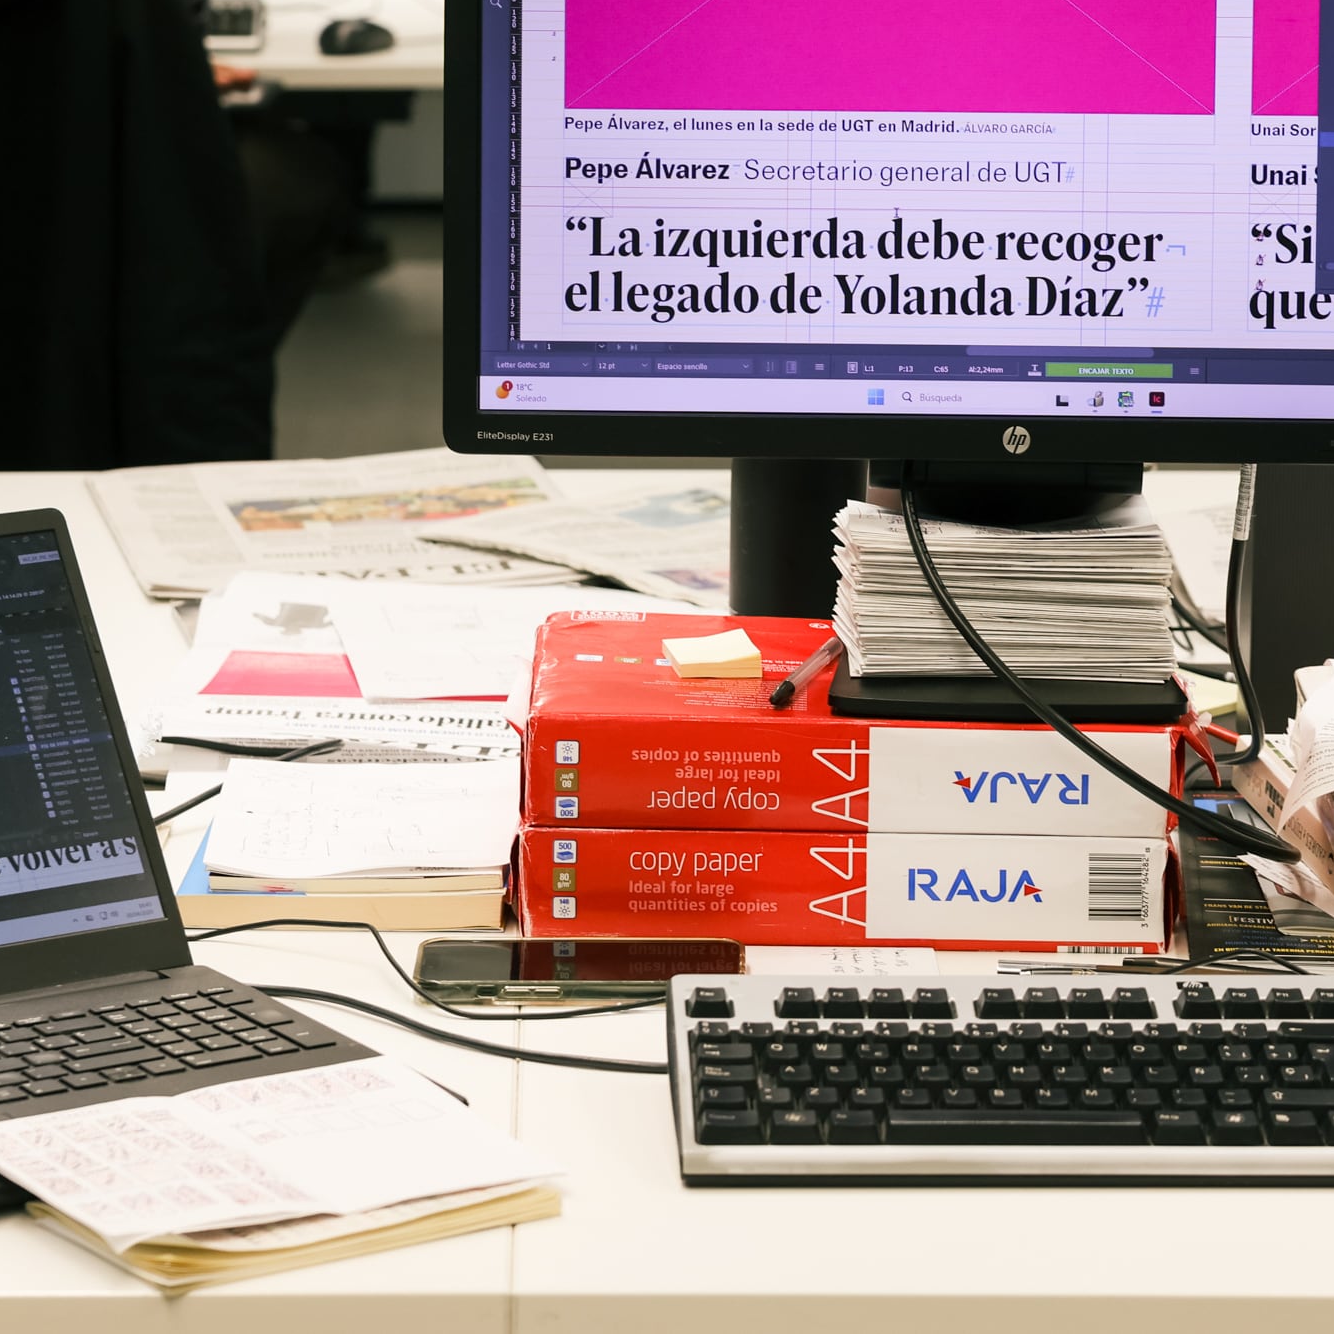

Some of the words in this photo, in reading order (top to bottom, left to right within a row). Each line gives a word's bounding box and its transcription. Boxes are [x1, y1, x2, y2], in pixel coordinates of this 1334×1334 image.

[565, 117, 603, 132] Pepe
[607, 114, 669, 133] Álvarez,
[673, 118, 687, 131] el
[692, 118, 733, 131] lunes
[737, 121, 755, 131] en
[760, 118, 773, 131] la
[778, 120, 814, 132] sede
[819, 120, 837, 132] de
[842, 119, 874, 133] UGT
[878, 122, 896, 133] en
[901, 120, 960, 133] Madrid.
[964, 121, 1007, 134] ÁLVARO
[1010, 122, 1052, 135] GARCÍA
[1251, 124, 1285, 136] Unai
[565, 157, 628, 184] Pepe
[635, 152, 730, 180] Álvarez
[744, 159, 873, 181] Secretario
[880, 161, 970, 186] general
[978, 162, 1007, 183] de
[1251, 164, 1307, 185] Unai
[565, 216, 643, 257] “La
[653, 216, 867, 268] izquierda
[877, 217, 984, 260] debe
[995, 231, 1163, 272] recoger
[1251, 224, 1313, 264] “Si
[564, 270, 600, 312] el
[611, 270, 759, 323] legado
[770, 272, 822, 314] de
[833, 273, 1015, 316] Yolanda
[1249, 289, 1332, 329] que
[1079, 368, 1109, 376] ENCAJAR
[1112, 368, 1133, 376] TEXTO
[516, 395, 547, 403] Soleado
[920, 393, 962, 404] Búsqueda
[477, 431, 530, 442] EliteDisplay
[533, 432, 553, 441] E231
[632, 748, 679, 764] copies
[683, 748, 699, 763] of
[704, 749, 781, 765] quantities
[675, 768, 713, 782] large
[717, 769, 739, 782] for
[744, 769, 780, 783] Ideal
[811, 739, 870, 827] A4
[647, 786, 716, 810] paper
[723, 787, 780, 810] copy
[953, 771, 1089, 805] RAJA
[629, 851, 686, 876] copy
[694, 852, 763, 877] paper
[629, 881, 665, 894] Ideal
[670, 881, 691, 894] for
[696, 881, 734, 897] large
[809, 838, 867, 927] A4
[908, 868, 1043, 903] RAJA
[629, 899, 705, 912] quantities
[710, 899, 727, 911] of
[730, 901, 778, 914] copies
[1141, 890, 1149, 918] 663777
